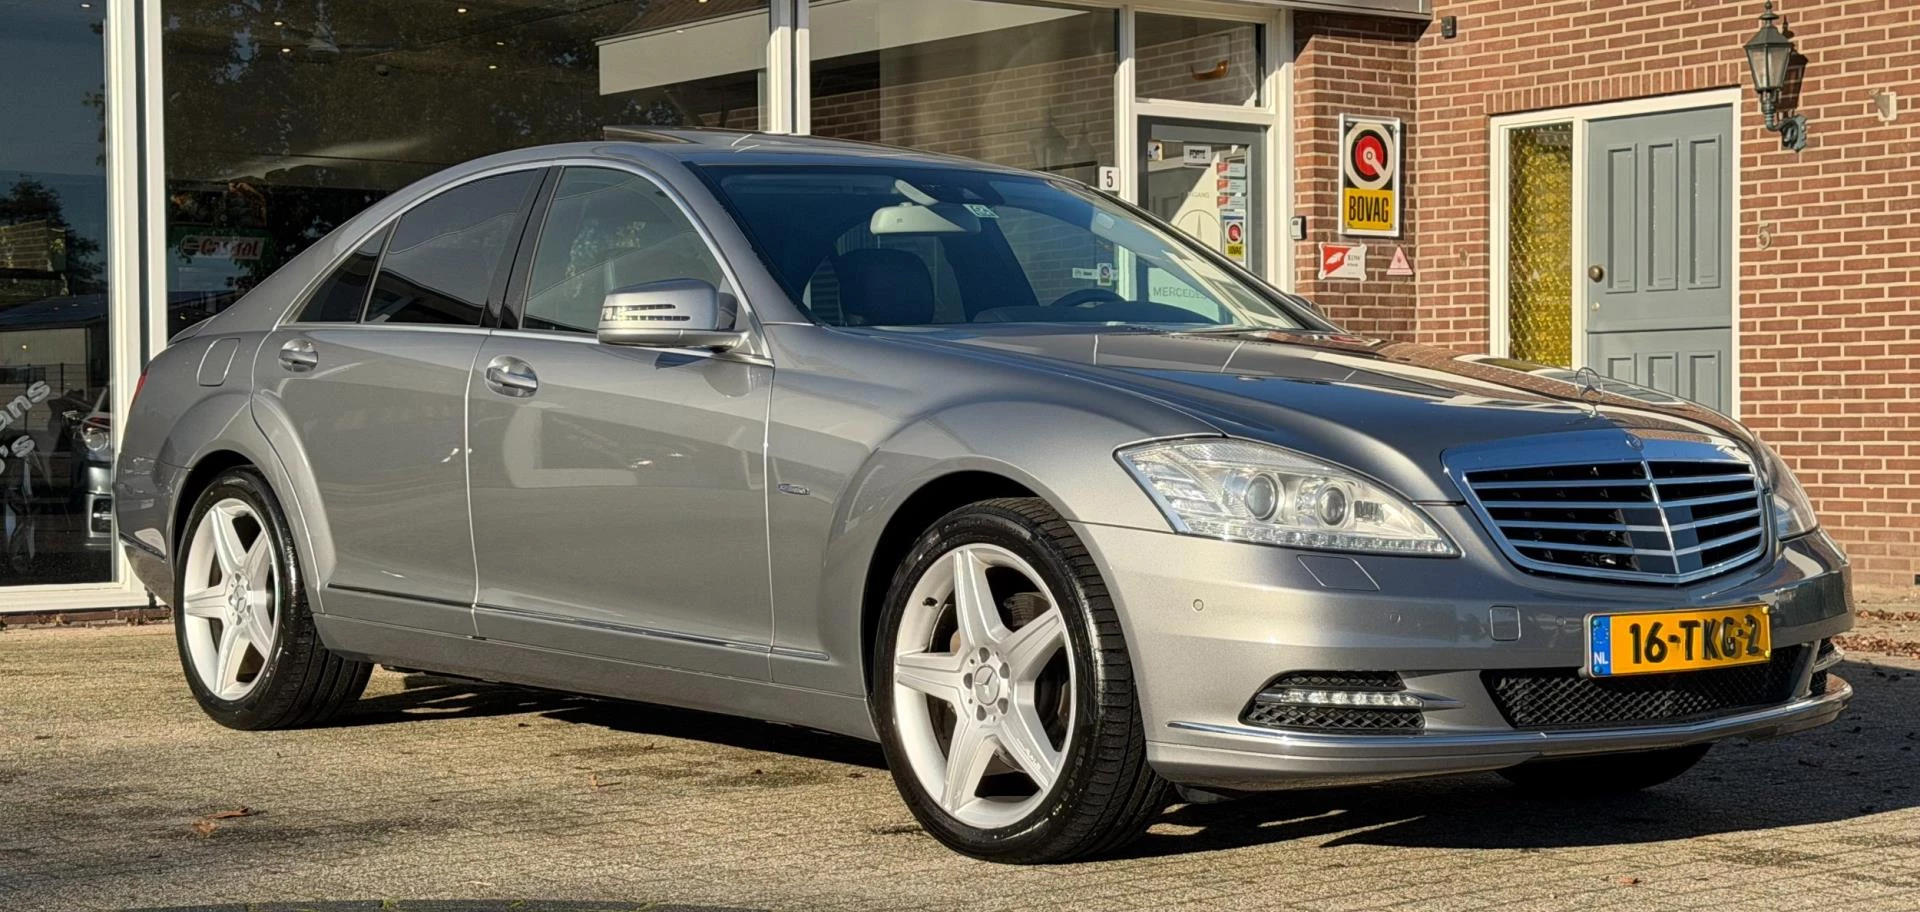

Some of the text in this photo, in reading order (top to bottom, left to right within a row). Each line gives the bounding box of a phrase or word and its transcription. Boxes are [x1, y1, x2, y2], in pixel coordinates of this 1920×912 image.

[1106, 170, 1114, 188] 5
[1348, 195, 1389, 223] BOVAG
[201, 238, 260, 257] Casrol
[1629, 614, 1761, 664] 16-TKG-2
[1593, 652, 1609, 665] NL
